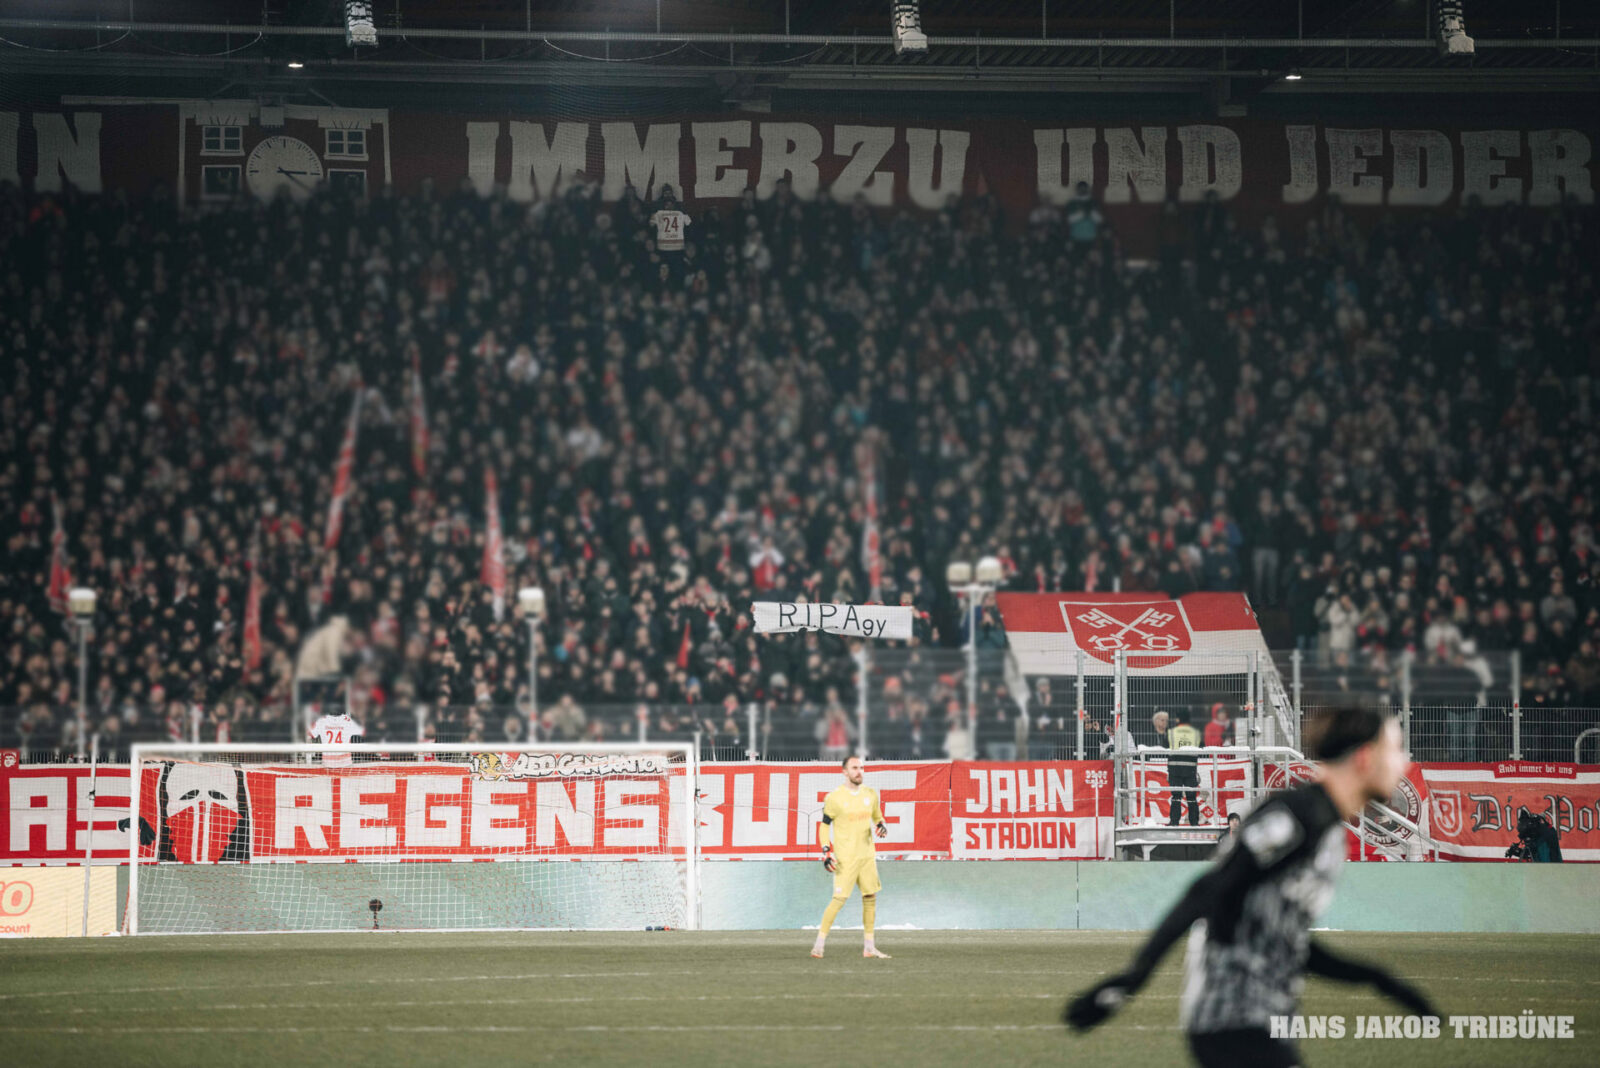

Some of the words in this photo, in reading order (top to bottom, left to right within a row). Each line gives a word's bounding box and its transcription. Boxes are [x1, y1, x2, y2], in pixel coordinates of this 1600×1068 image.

[466, 120, 970, 209] IMMERZU
[1033, 125, 1242, 205] UND
[1282, 125, 1596, 206] JEDER
[663, 216, 679, 233] 24
[843, 605, 887, 637] Agy
[1498, 763, 1516, 774] Andi
[1519, 763, 1542, 774] immer
[1545, 763, 1556, 774] bei
[1558, 766, 1573, 775] uns
[966, 768, 1073, 814] JAHN
[965, 822, 1076, 849] STADION
